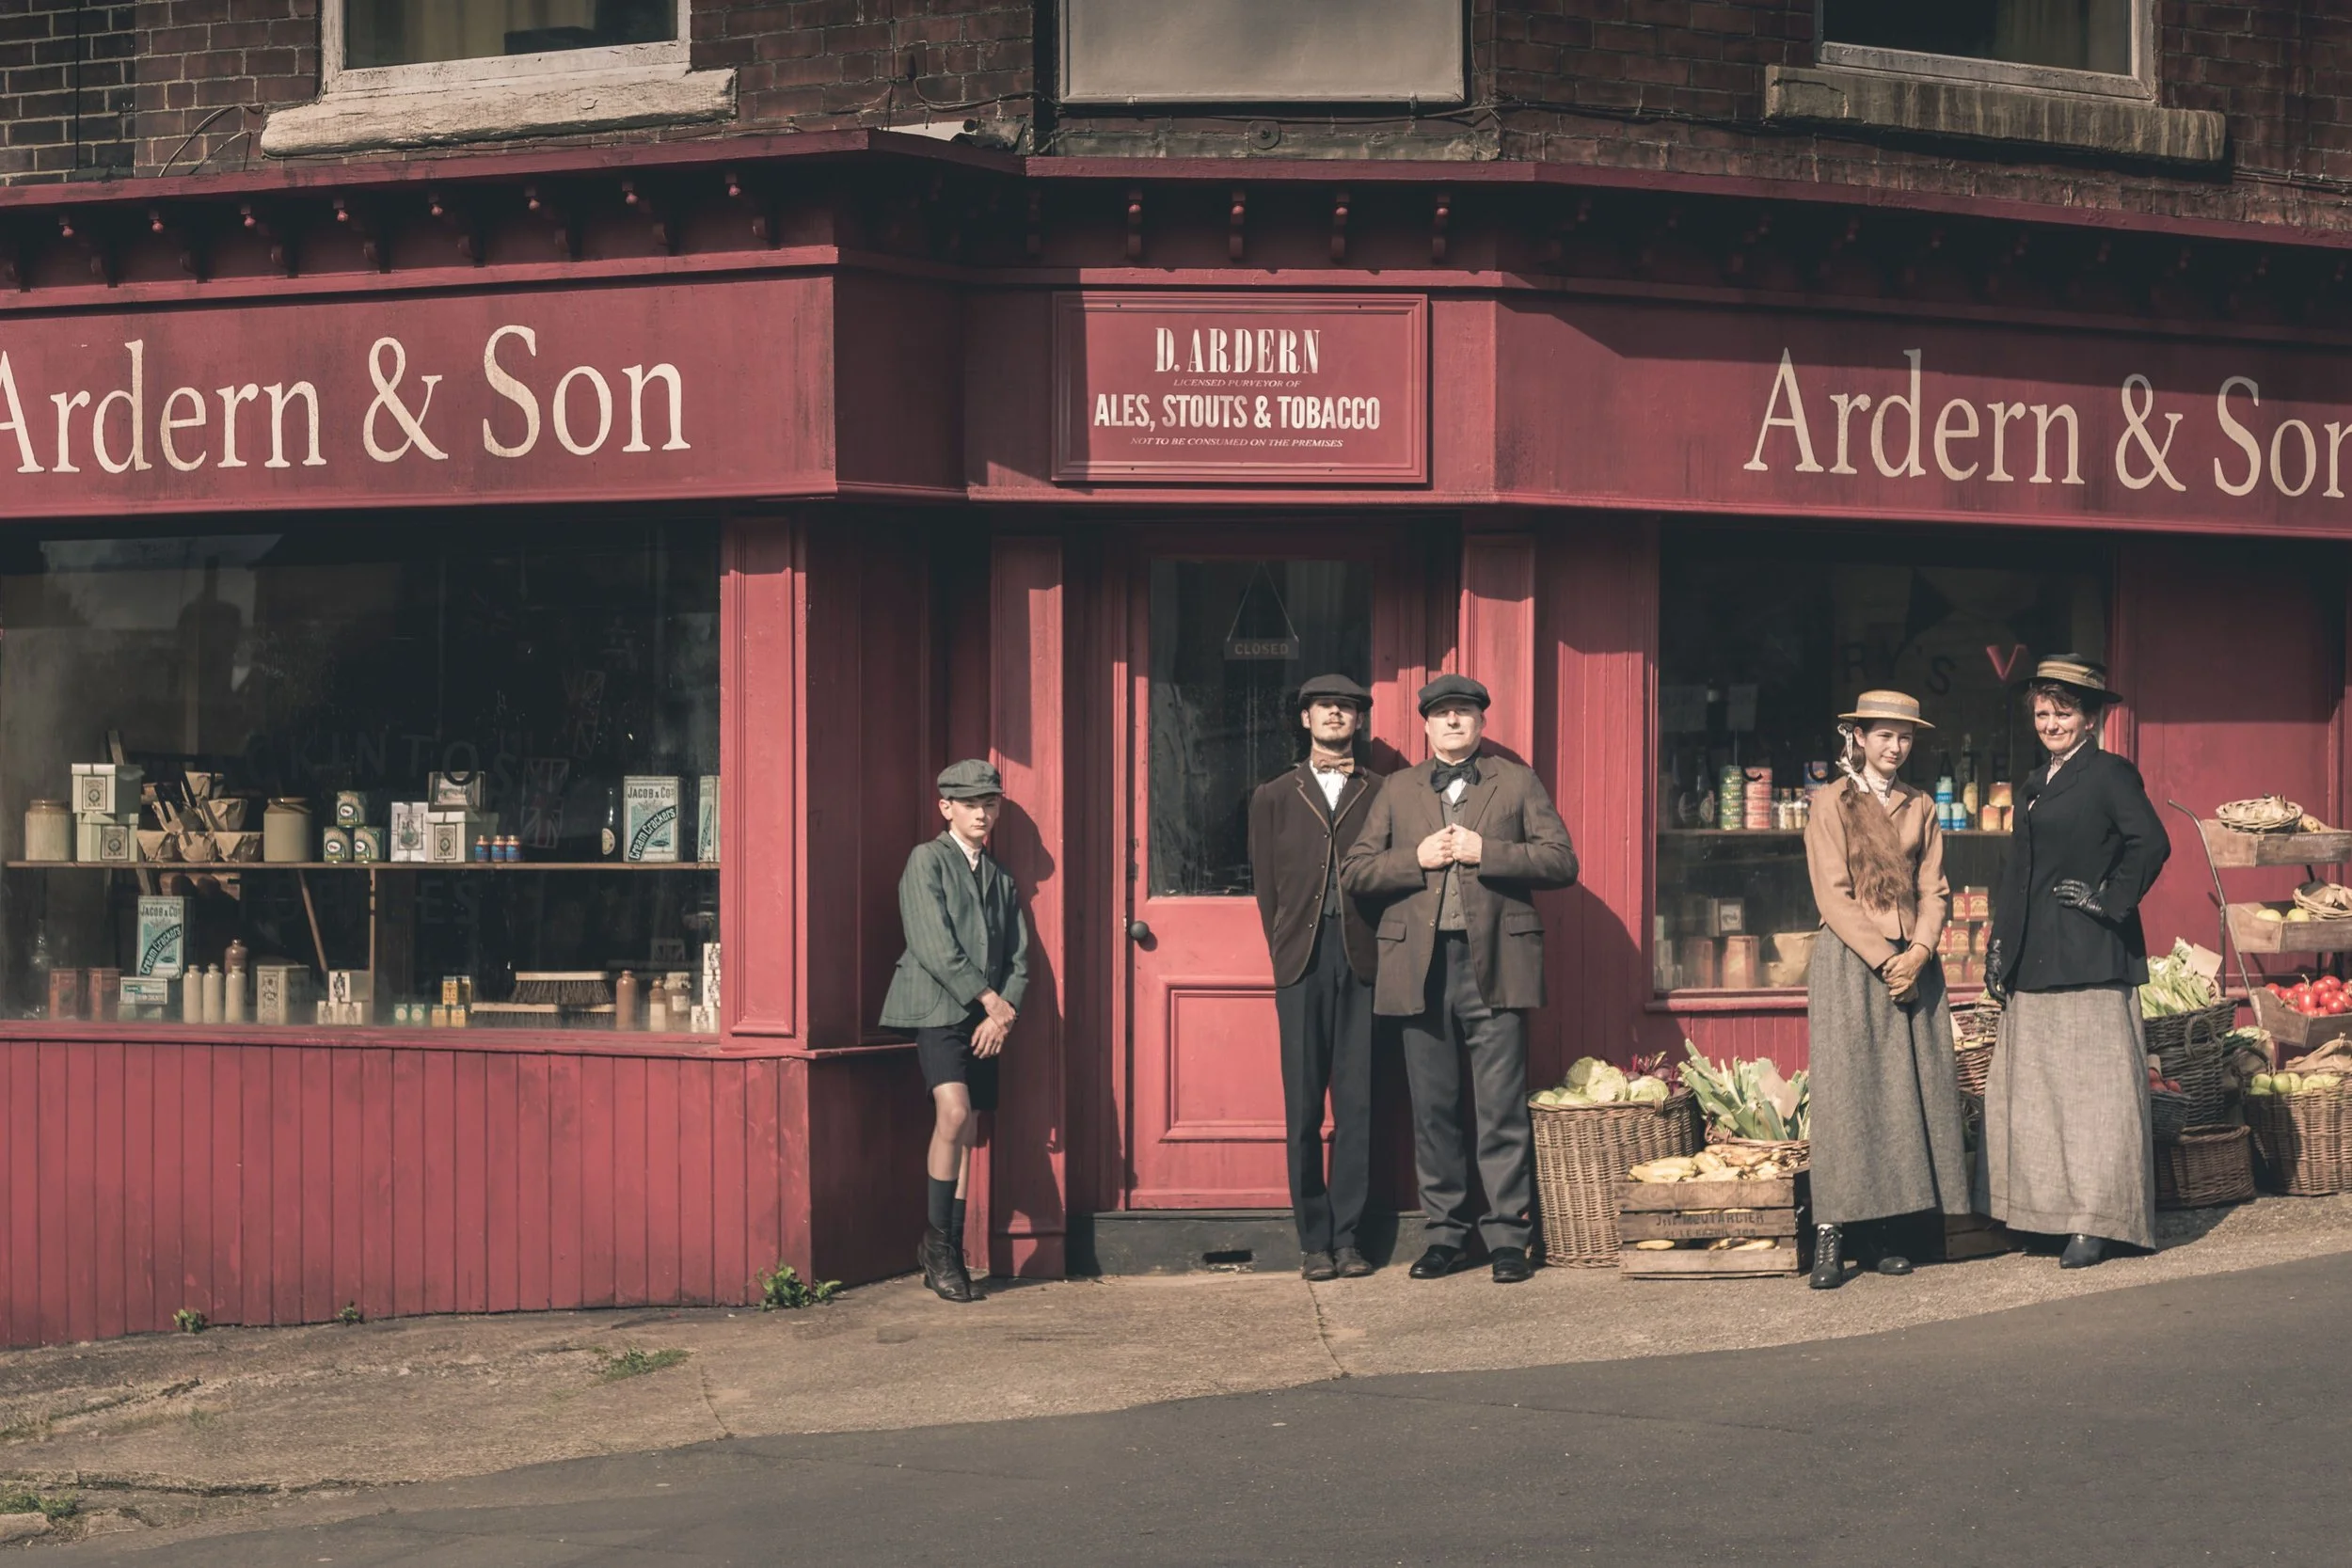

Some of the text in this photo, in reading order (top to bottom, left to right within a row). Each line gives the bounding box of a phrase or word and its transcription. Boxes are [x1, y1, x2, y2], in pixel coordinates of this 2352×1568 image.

[1154, 327, 1321, 374] D. ARDERN
[362, 336, 449, 464] &
[482, 325, 692, 459] Son
[1173, 378, 1302, 388] LICENSED PURVEYOR OF
[1093, 393, 1381, 432] ALES, STOUTS & TOBACCO
[1743, 347, 2086, 485] Ardern
[2115, 373, 2187, 492] &
[1130, 436, 1344, 448] NOT TO BE CONSUMED ON THE PREMISES
[1234, 642, 1289, 656] CLOSED
[627, 786, 654, 799] JACOB
[629, 830, 649, 860] Cream
[643, 807, 675, 834] Crackers
[141, 949, 158, 974] Cream
[153, 927, 182, 949] Crackers
